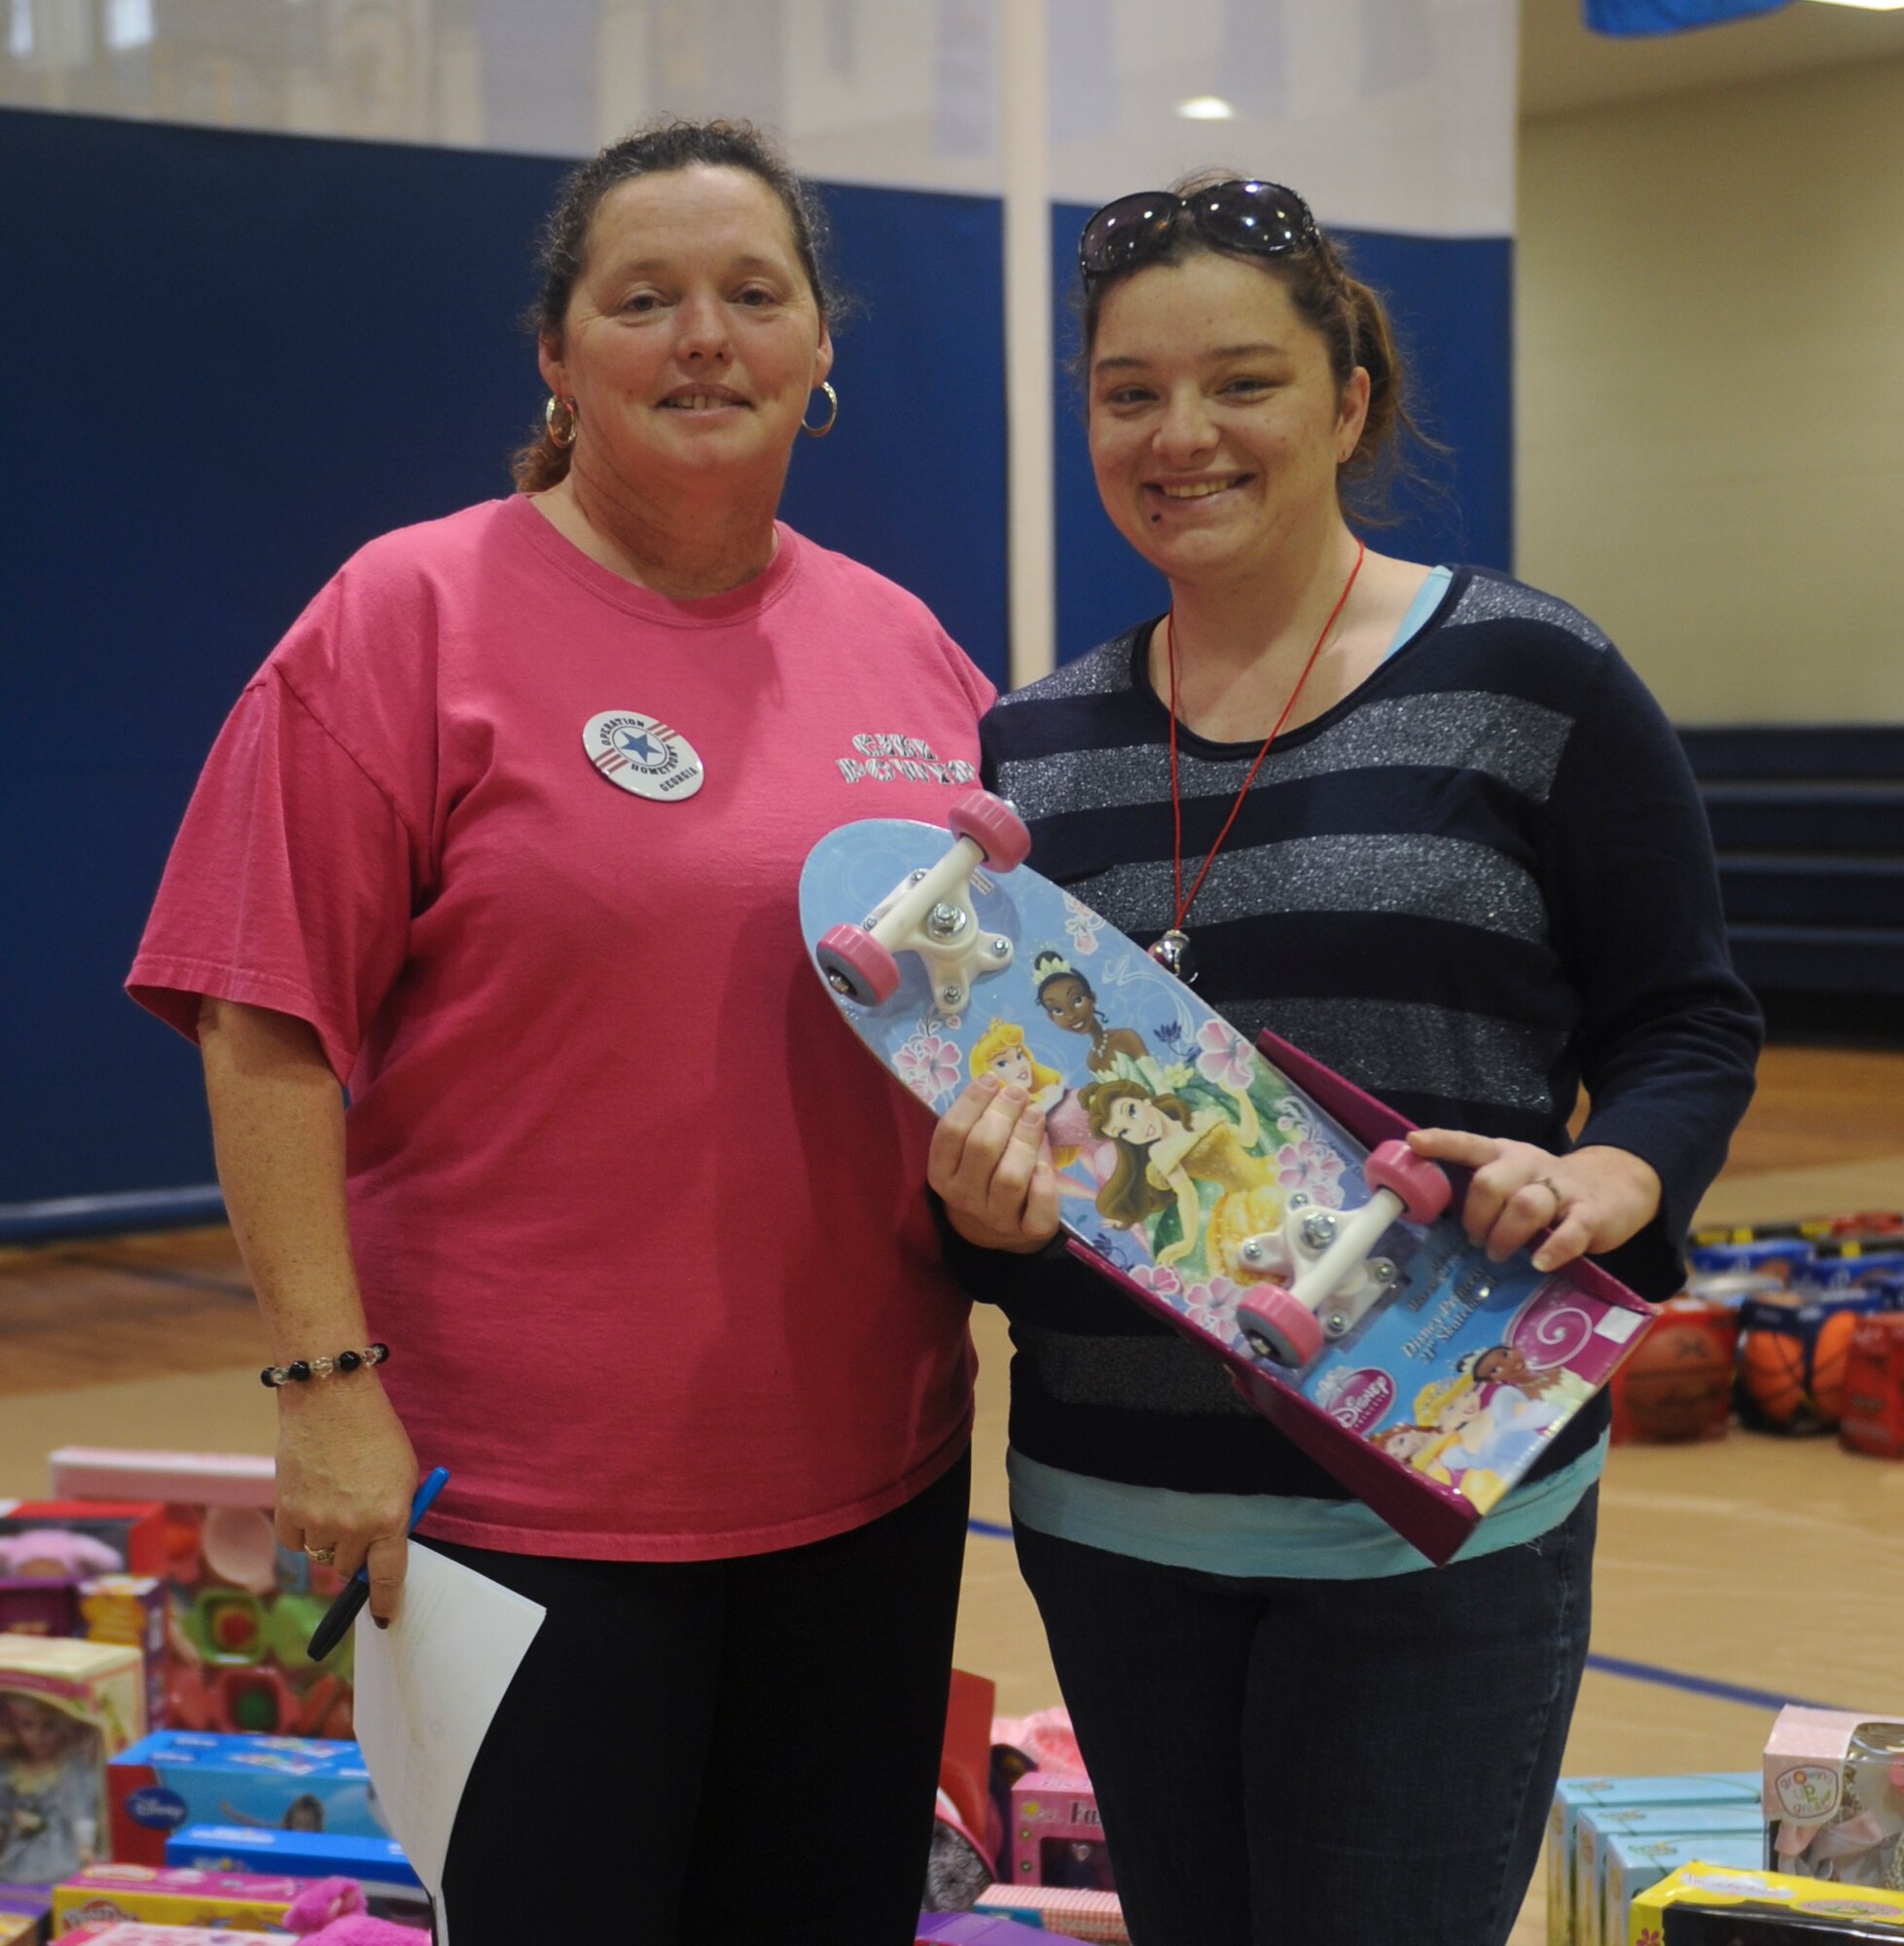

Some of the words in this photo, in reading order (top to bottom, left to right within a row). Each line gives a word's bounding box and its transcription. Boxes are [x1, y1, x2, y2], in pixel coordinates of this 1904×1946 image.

[599, 718, 645, 746] OPERATION
[630, 743, 679, 775] HOMEFRONT
[852, 733, 940, 761] GIRL
[659, 766, 699, 792] GEORGIA
[835, 758, 975, 784] POWER
[1435, 1274, 1498, 1343] Skatebod
[1400, 1312, 1445, 1358] Disney
